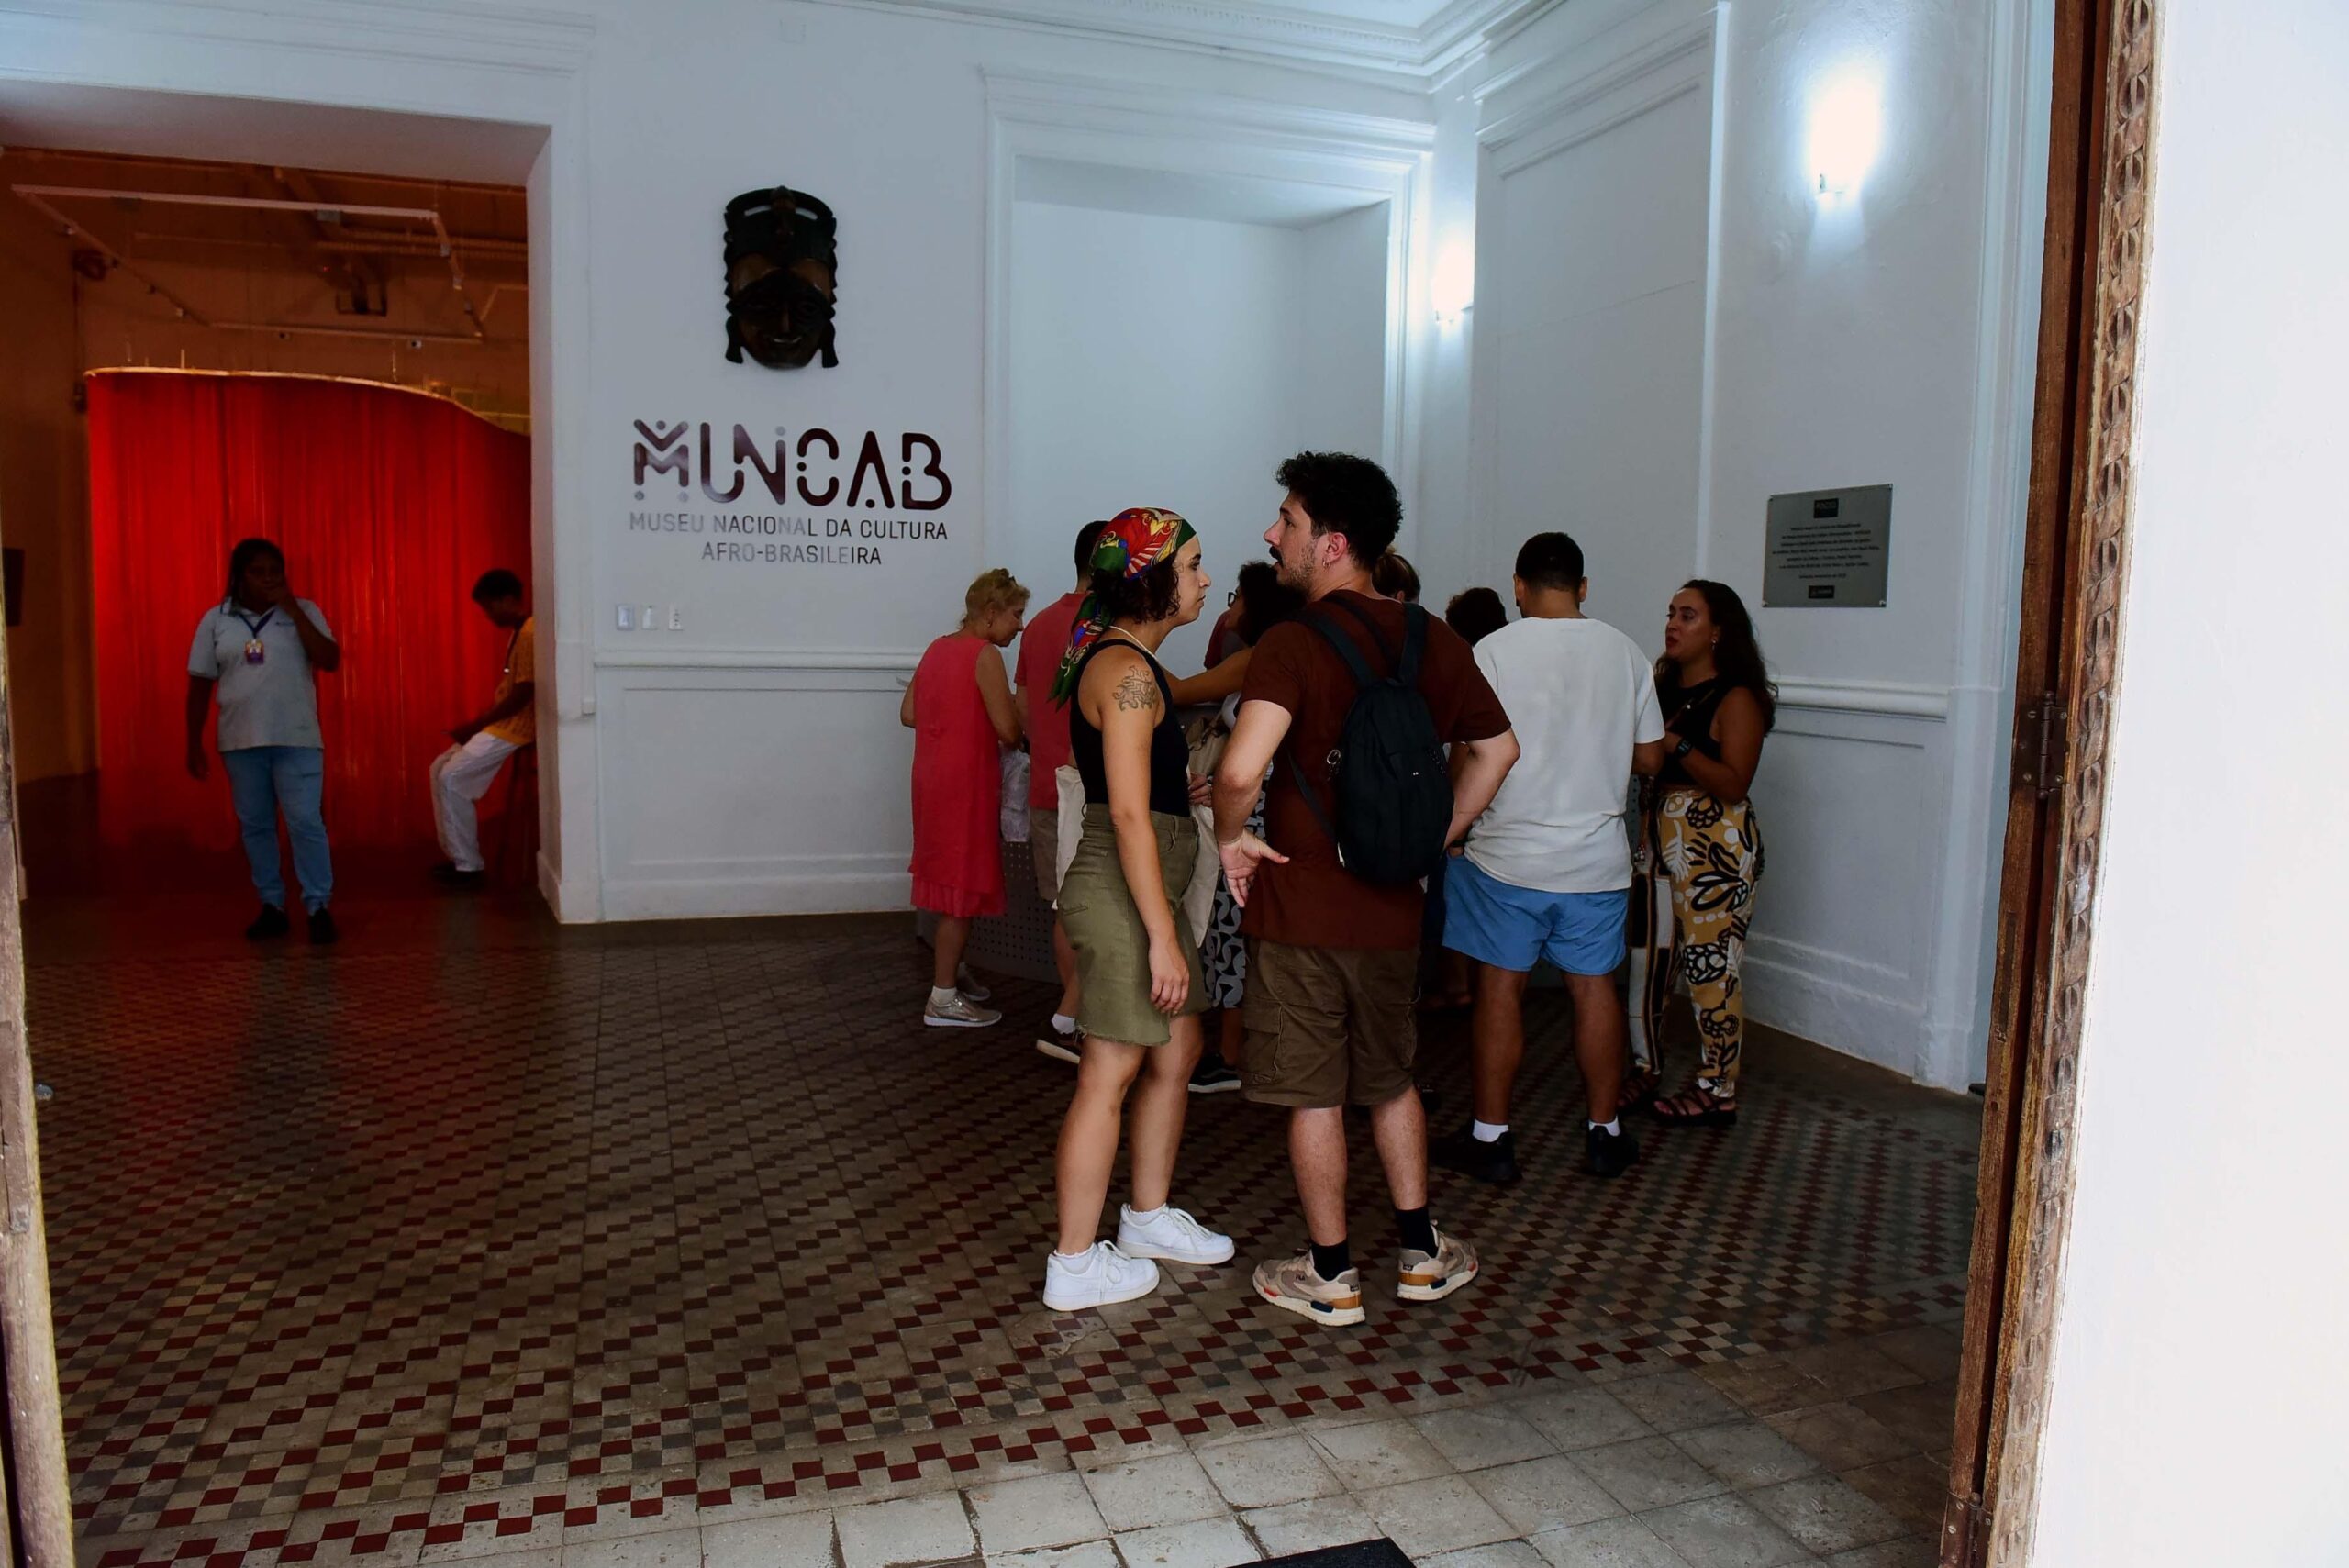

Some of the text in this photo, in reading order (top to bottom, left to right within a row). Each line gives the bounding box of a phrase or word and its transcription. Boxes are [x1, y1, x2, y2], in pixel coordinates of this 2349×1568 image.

[633, 419, 952, 511] MUNCAB
[629, 512, 948, 539] MUSEU NACIONAL DA CULTURA
[702, 541, 882, 564] AFRO-BRASILEIRA
